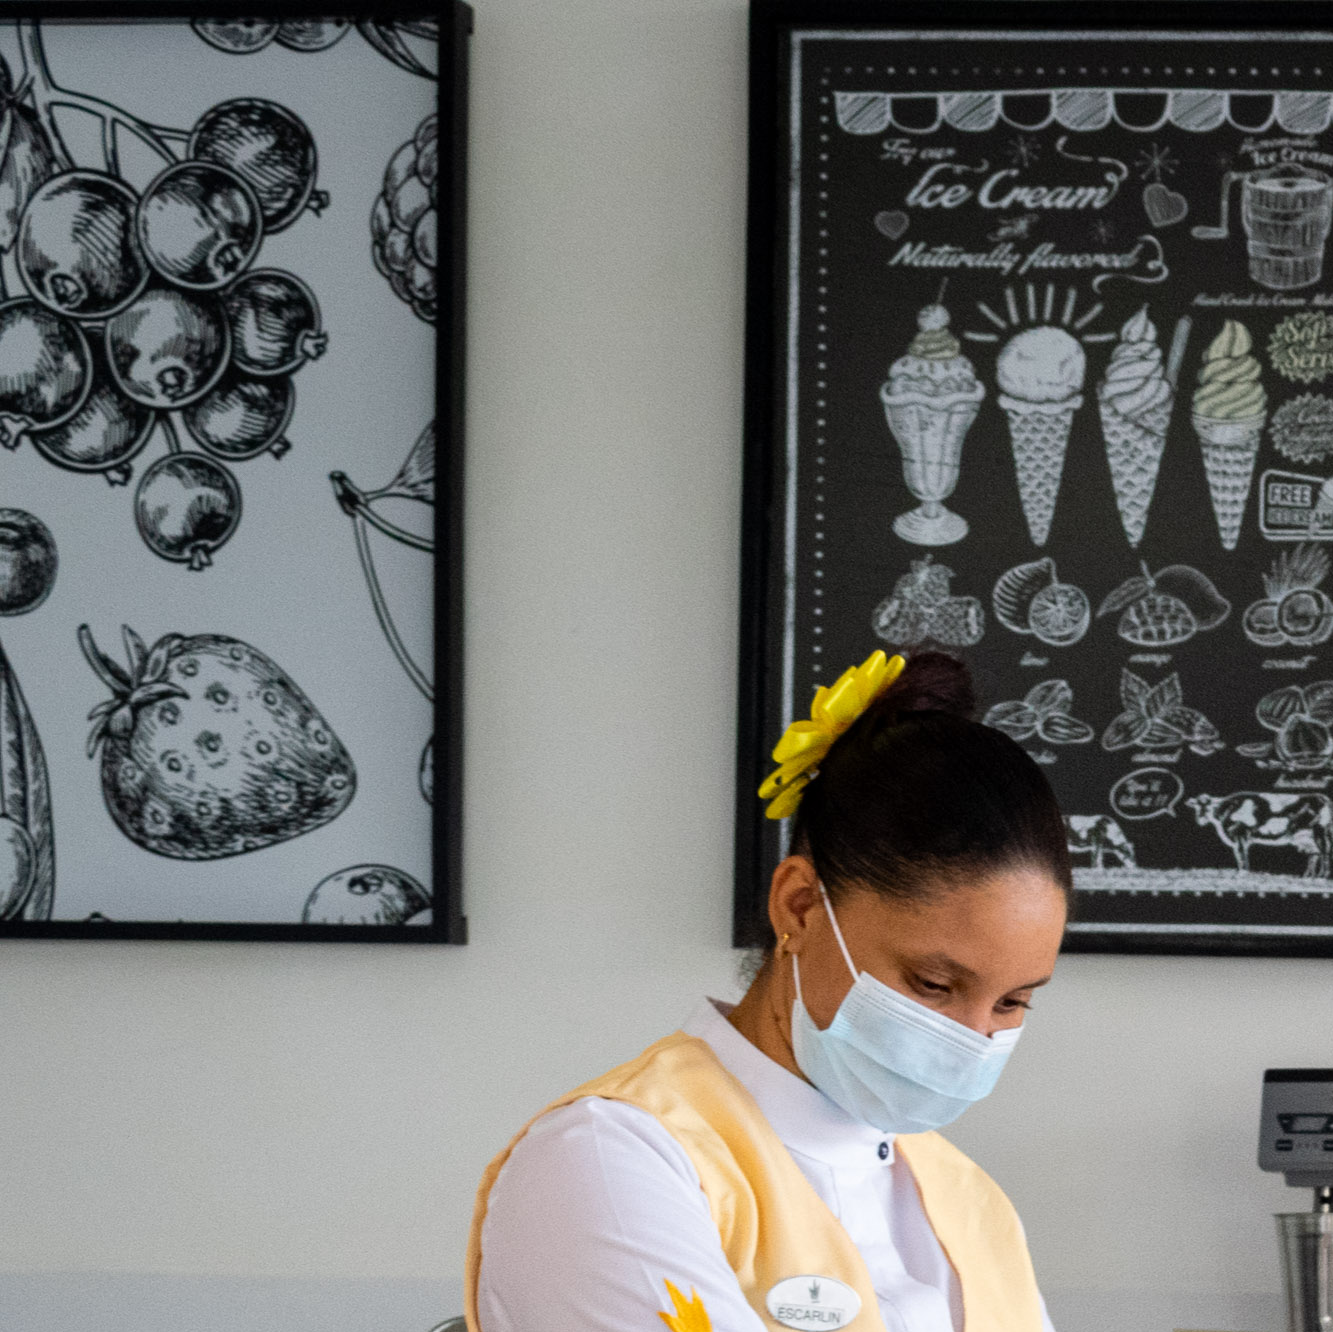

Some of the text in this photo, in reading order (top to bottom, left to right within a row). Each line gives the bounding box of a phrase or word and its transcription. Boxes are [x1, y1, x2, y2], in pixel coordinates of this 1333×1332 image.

[905, 162, 1118, 209] Ice Cream
[888, 241, 1148, 276] Naturally flavored
[1270, 485, 1309, 504] FREE
[777, 1306, 841, 1324] ESCARLIN
